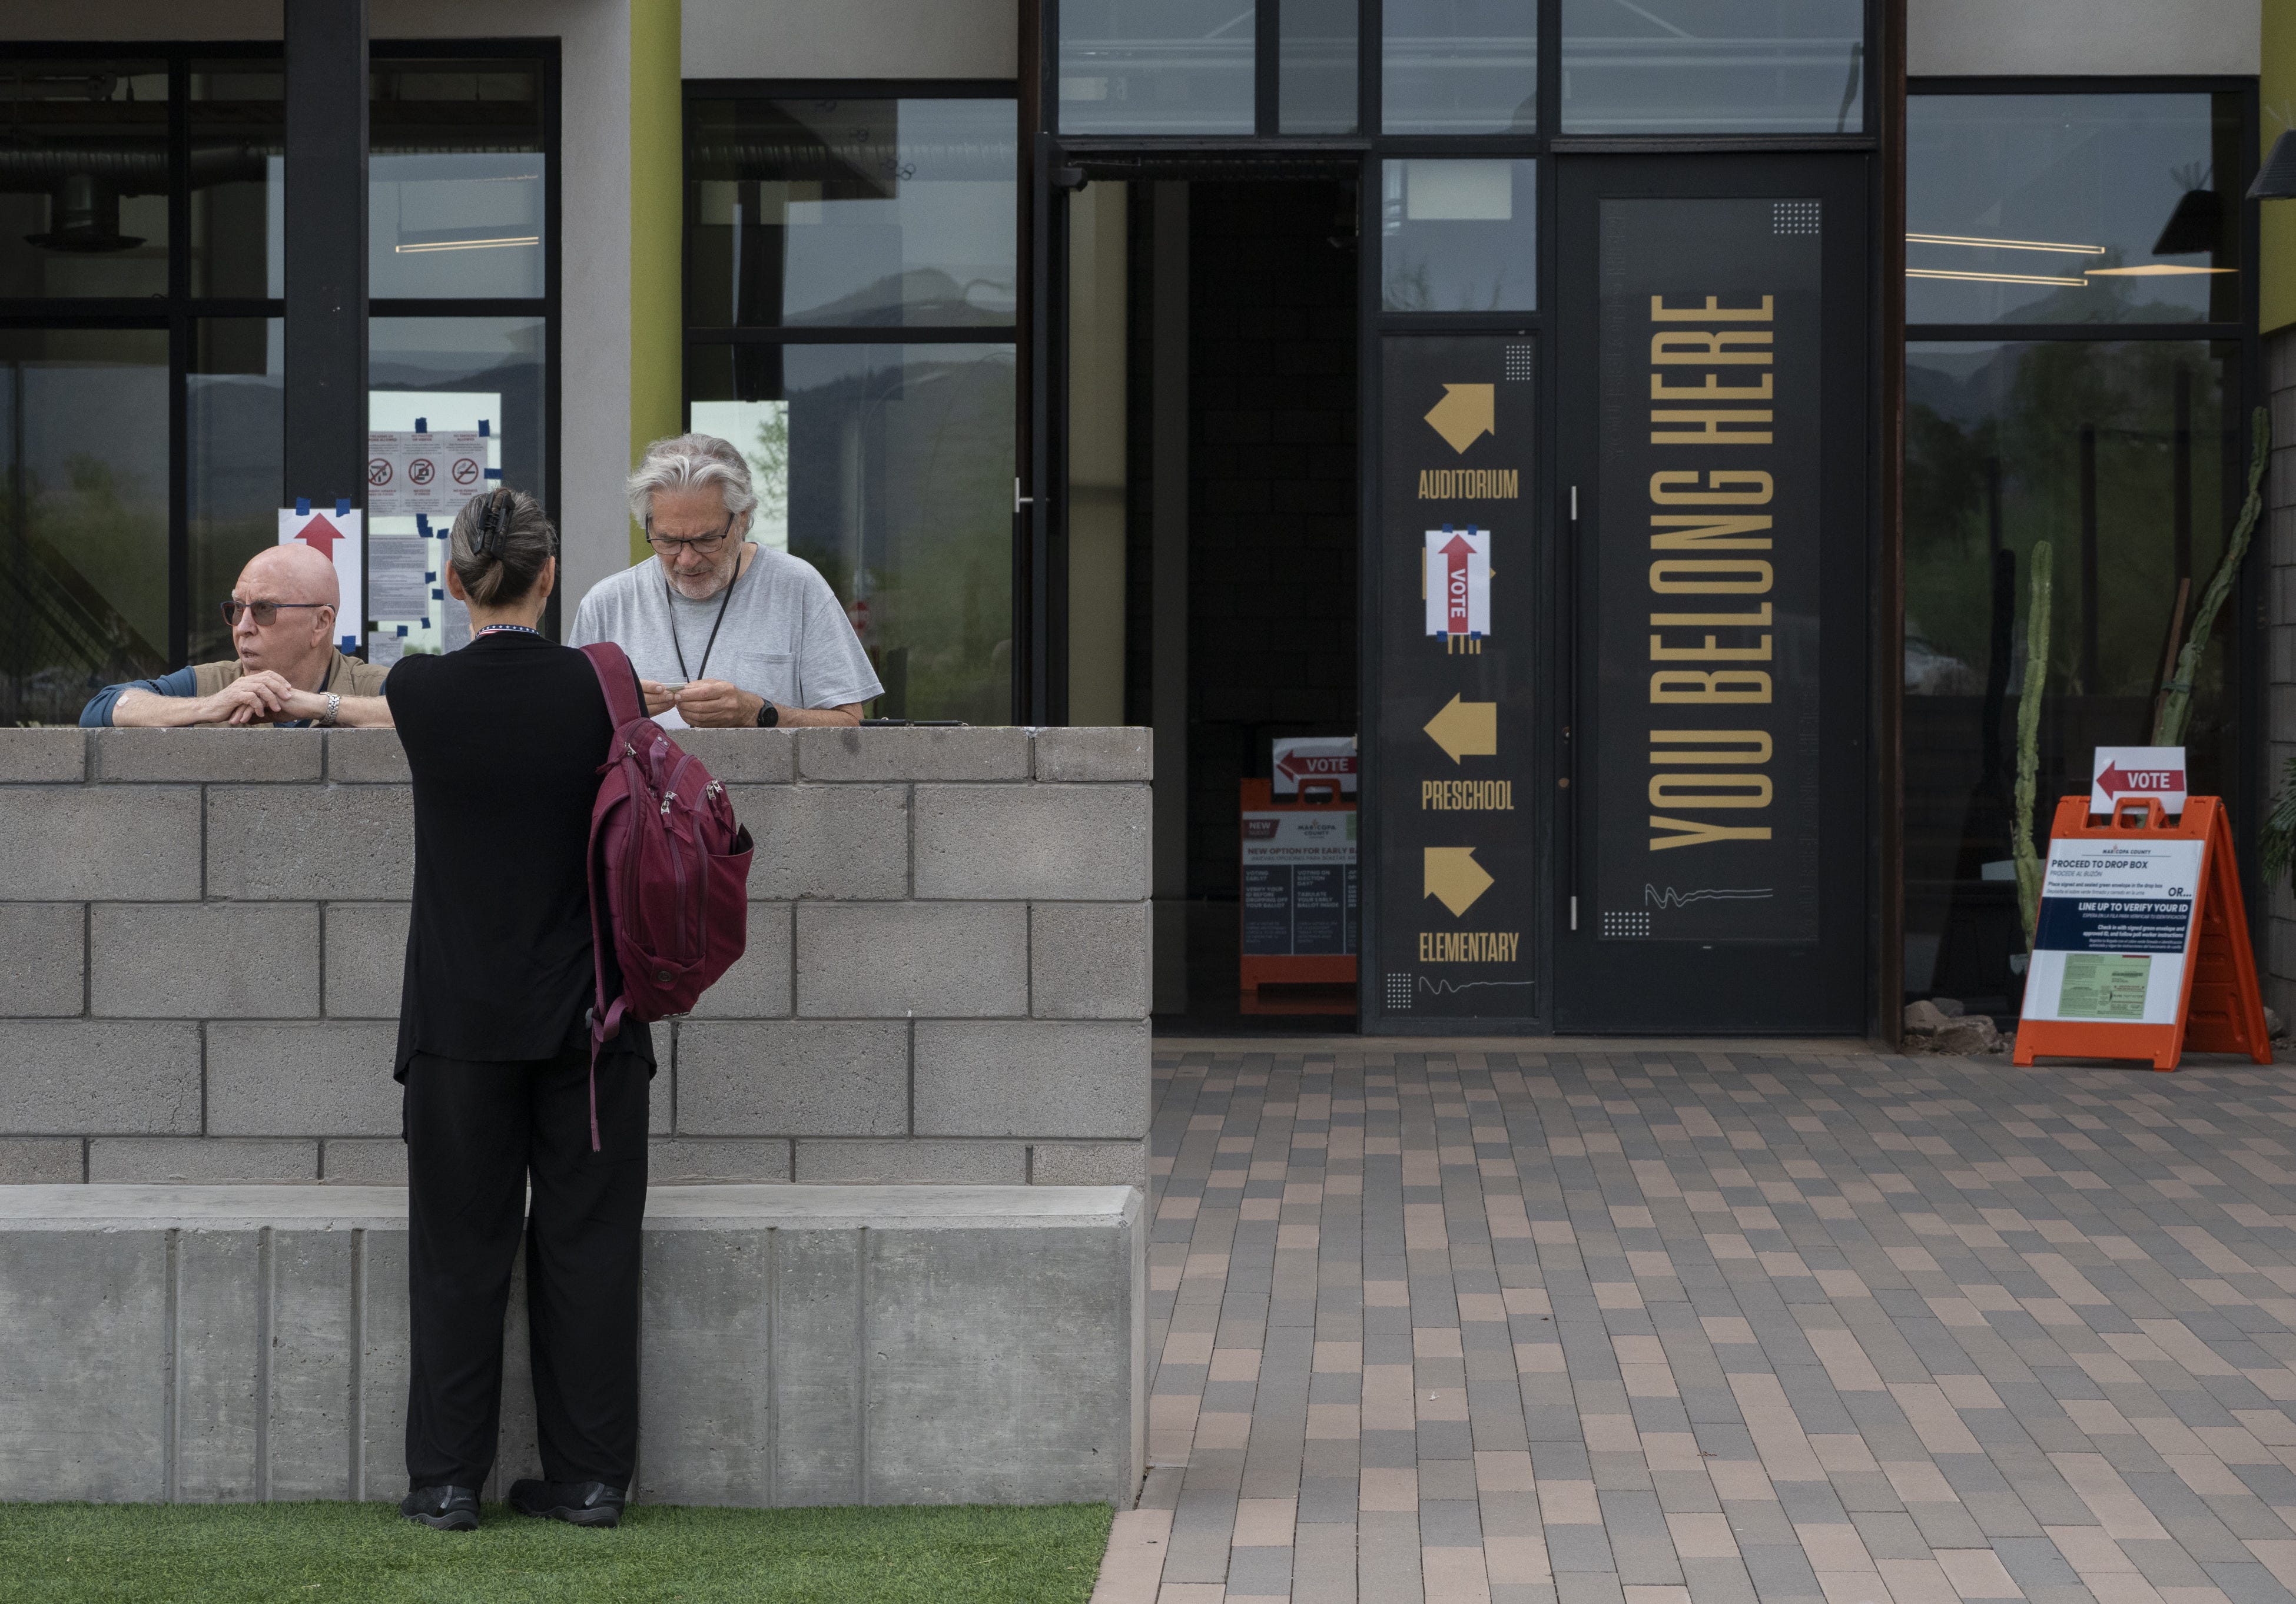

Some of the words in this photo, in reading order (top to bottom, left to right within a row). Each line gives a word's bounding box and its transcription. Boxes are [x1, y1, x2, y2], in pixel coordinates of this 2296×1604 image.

[1651, 295, 1773, 444] HERE
[1418, 469, 1518, 499] AUDITORIUM
[1451, 568, 1466, 618] VOTE
[1649, 470, 1773, 703] BELONG
[1306, 758, 1349, 772] VOTE
[1422, 780, 1514, 811] PRESCHOOL
[1648, 730, 1773, 851] YOU
[2127, 772, 2170, 789] VOTE
[2051, 859, 2090, 869] PROCEED
[2092, 860, 2103, 869] TO
[2105, 861, 2129, 869] DROP
[2129, 861, 2149, 869] BOX
[2078, 902, 2096, 911] LINE
[2097, 903, 2110, 911] UP
[2111, 903, 2122, 911] TO
[2124, 904, 2154, 912] VERIFY
[2154, 904, 2178, 912] YOUR
[2178, 904, 2188, 912] ID
[2168, 887, 2192, 897] OR...
[1419, 932, 1519, 962] ELEMENTARY
